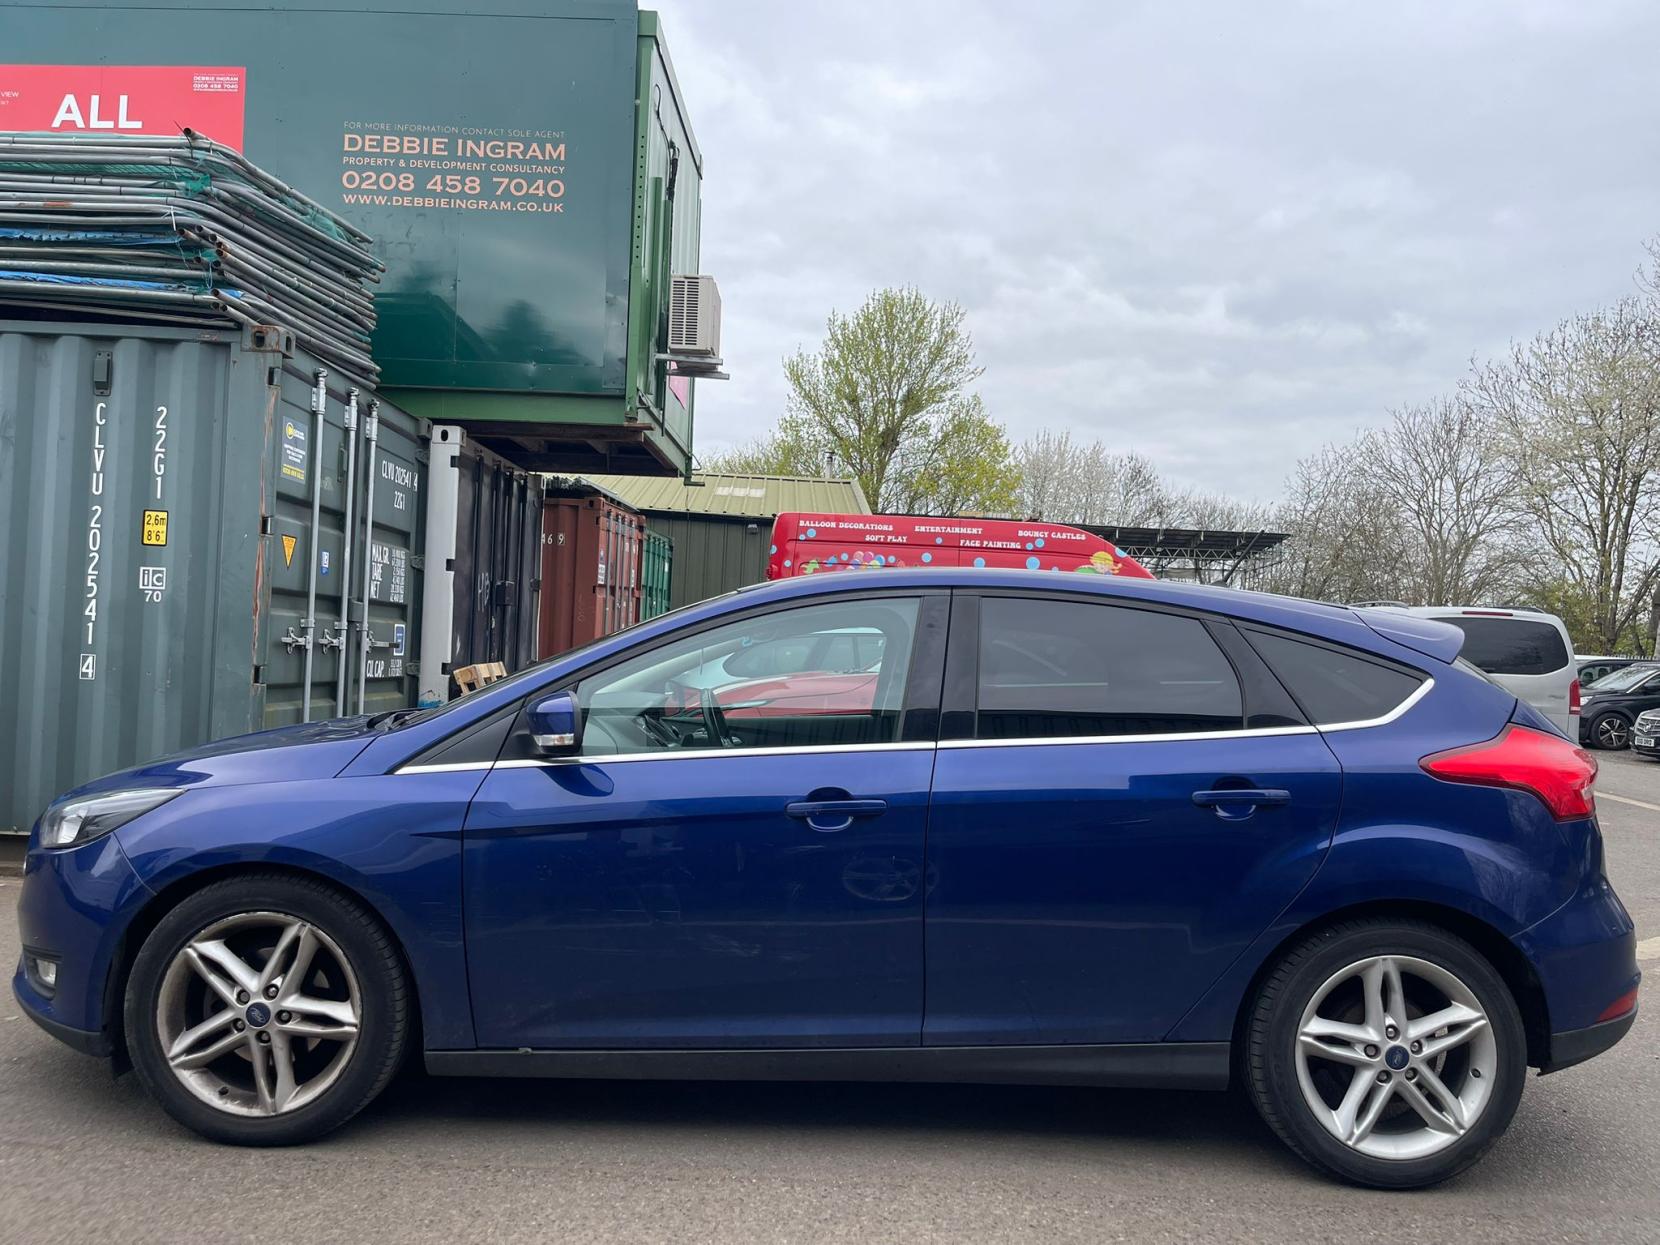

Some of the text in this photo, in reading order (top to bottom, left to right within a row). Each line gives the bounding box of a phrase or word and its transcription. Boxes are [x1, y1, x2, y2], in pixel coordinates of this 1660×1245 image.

[52, 94, 142, 129] ALL
[344, 121, 565, 139] FOR MORE INFORMATION CONTACT SOLE AGENT
[344, 134, 566, 161] DEBBIE INGRAM
[343, 157, 565, 174] PROPERTY & DEVELOPMENT CONSULTANCY
[342, 170, 565, 198] 0208 458 7040
[343, 194, 564, 213] WWW.DEBBIEINGRAM.CO.UK
[91, 402, 106, 495] CLVU
[799, 520, 894, 531] BALLOON DECORATIONS
[915, 525, 983, 534] ENTERTAINMENT
[1018, 530, 1086, 540] BOUNCY CASTLES
[983, 541, 1021, 549] PAINTING
[144, 590, 162, 602] 70
